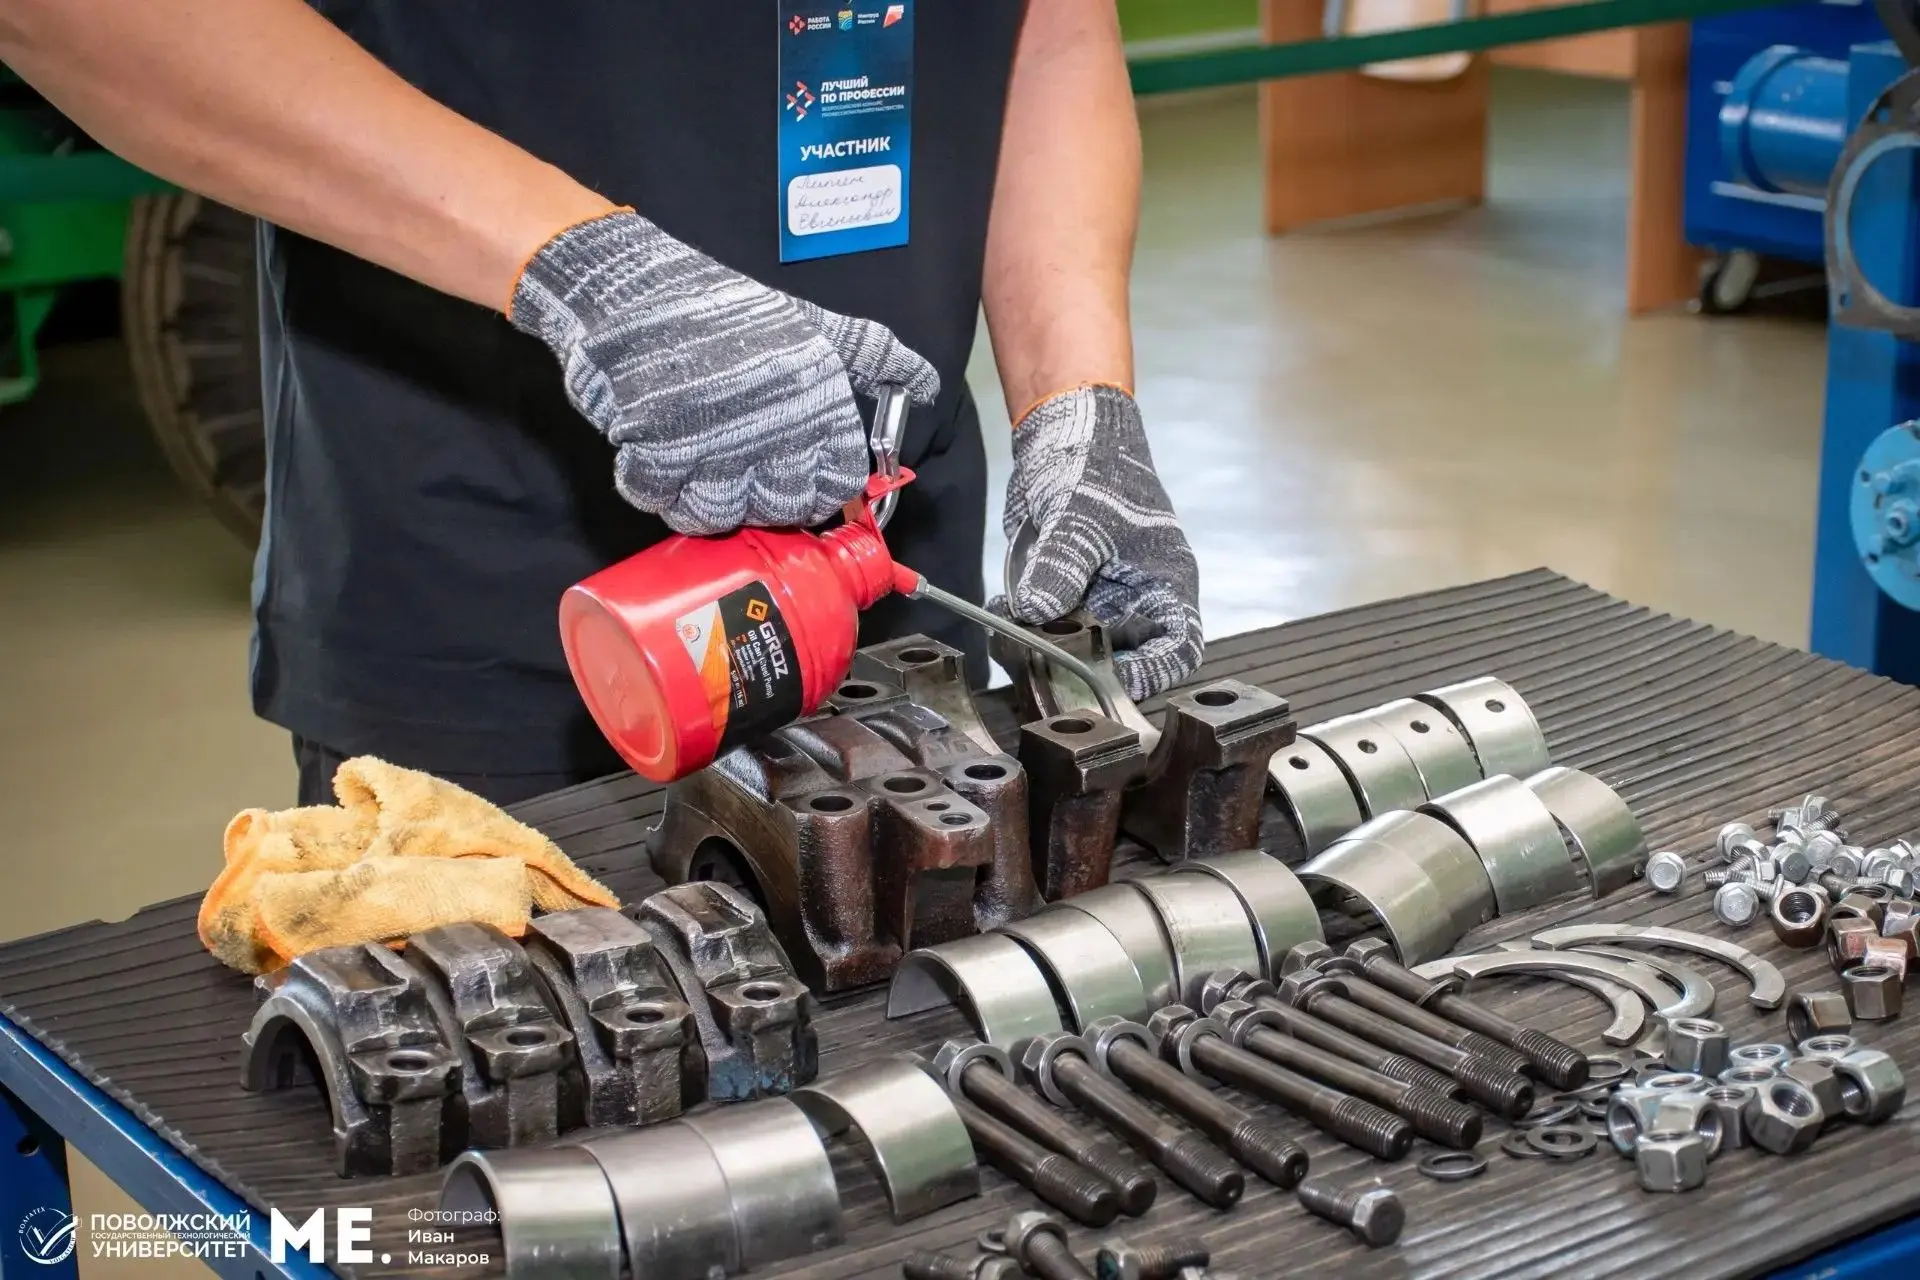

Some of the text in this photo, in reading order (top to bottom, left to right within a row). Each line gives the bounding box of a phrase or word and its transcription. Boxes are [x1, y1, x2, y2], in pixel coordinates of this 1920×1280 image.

[807, 16, 830, 24] РАБОТА
[807, 22, 832, 30] РОССИИ
[820, 76, 869, 92] ЛУЧШИЙ
[820, 86, 905, 104] ПО ПРОФЕССИИ
[800, 136, 891, 161] УЧАСТНИК
[747, 630, 758, 642] Oil
[752, 641, 762, 657] Can
[759, 621, 789, 680] GROZ
